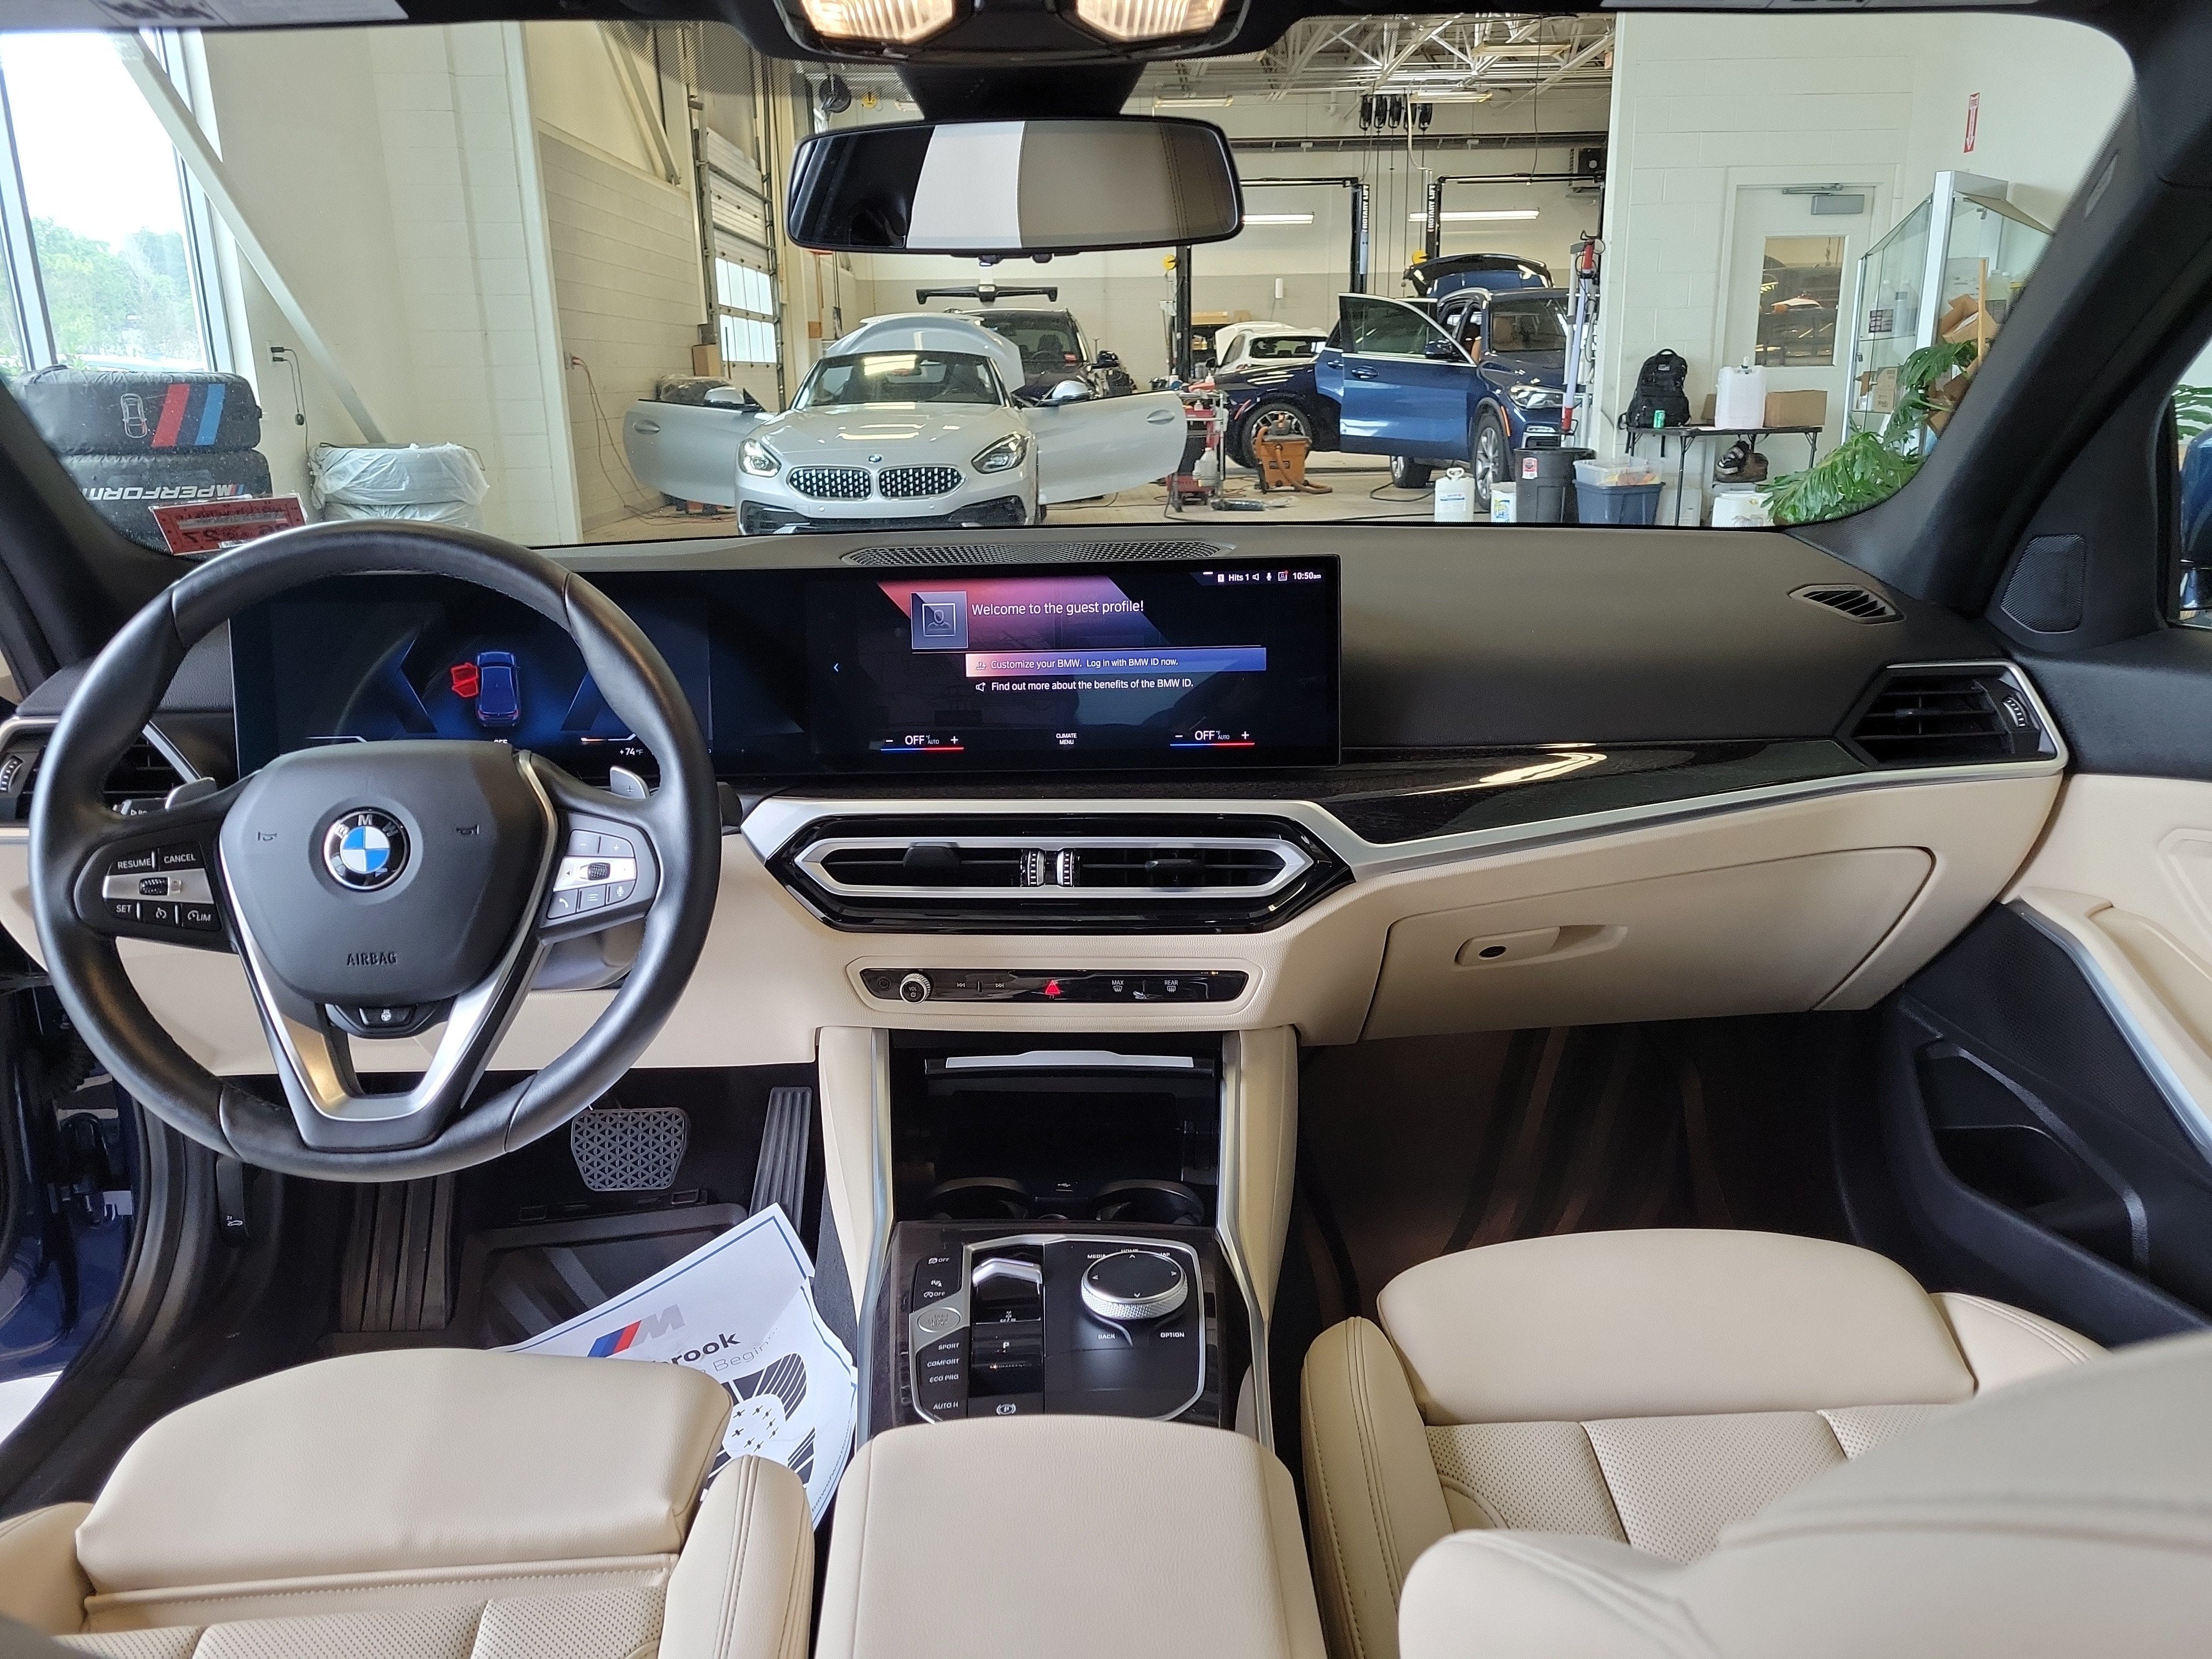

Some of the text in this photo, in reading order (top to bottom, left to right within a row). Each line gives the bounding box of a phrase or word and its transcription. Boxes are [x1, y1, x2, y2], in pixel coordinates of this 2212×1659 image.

[972, 600, 1144, 616] Welcome to the guest profile!
[991, 660, 1035, 669] Customize
[1036, 661, 1056, 670] your
[1057, 659, 1082, 668] BMW.
[1086, 659, 1101, 669] Log
[1103, 659, 1110, 667] in
[1111, 658, 1127, 667] with
[1128, 658, 1149, 667] BMW
[991, 682, 1010, 691] Find
[1012, 682, 1026, 691] out
[1052, 681, 1077, 690] about
[1078, 680, 1092, 689] the
[1094, 680, 1128, 689] benefits
[1130, 679, 1139, 689] of
[1141, 679, 1155, 688] the
[1157, 679, 1180, 687] BMW
[1182, 678, 1194, 687] ID.
[905, 735, 925, 746] OFF
[1194, 730, 1215, 741] OFF
[334, 814, 399, 839] BMW
[117, 857, 152, 870] RESUME
[163, 853, 196, 864] CANCEL
[116, 905, 132, 913] SET
[196, 913, 212, 922] LIM
[347, 952, 397, 966] AIRBAG
[938, 1342, 960, 1351] SPORT
[927, 1358, 960, 1368] COMFORT
[929, 1375, 944, 1383] ECO
[933, 1401, 952, 1410] AUTO
